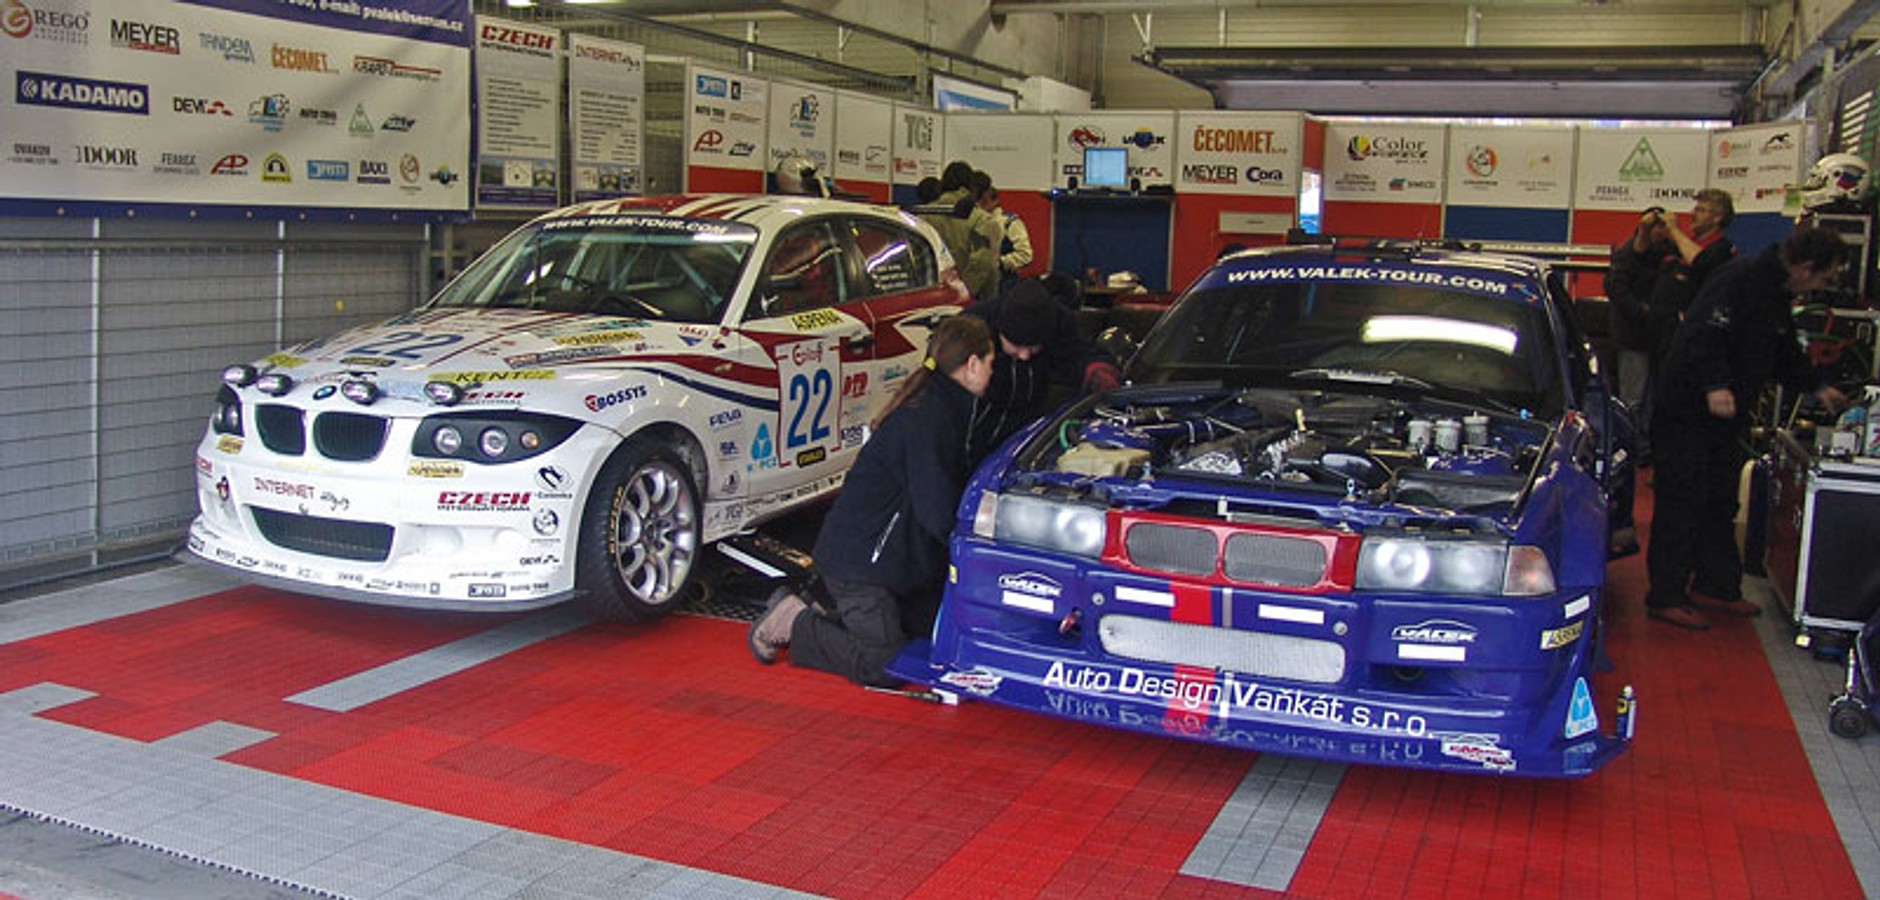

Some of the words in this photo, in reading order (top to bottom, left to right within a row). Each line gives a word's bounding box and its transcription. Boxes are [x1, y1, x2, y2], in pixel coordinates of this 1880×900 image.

[110, 19, 180, 46] MEYER
[481, 25, 555, 49] CZECH
[41, 80, 145, 107] KADAMO
[1193, 125, 1275, 153] ČECOMET
[1372, 137, 1425, 151] Color
[1182, 165, 1238, 183] MEYER
[1245, 166, 1283, 183] Cora
[1227, 267, 1507, 295] WWW.VALEK-TOUR.COM
[597, 385, 647, 410] BOSSYS
[787, 368, 833, 449] 22
[254, 477, 316, 500] INTERNET
[437, 491, 532, 505] CZECH
[1043, 661, 1111, 691] Auto
[1118, 667, 1222, 708] Design
[1231, 681, 1344, 723] Vaňkát
[1351, 704, 1435, 739] s.r.o.
